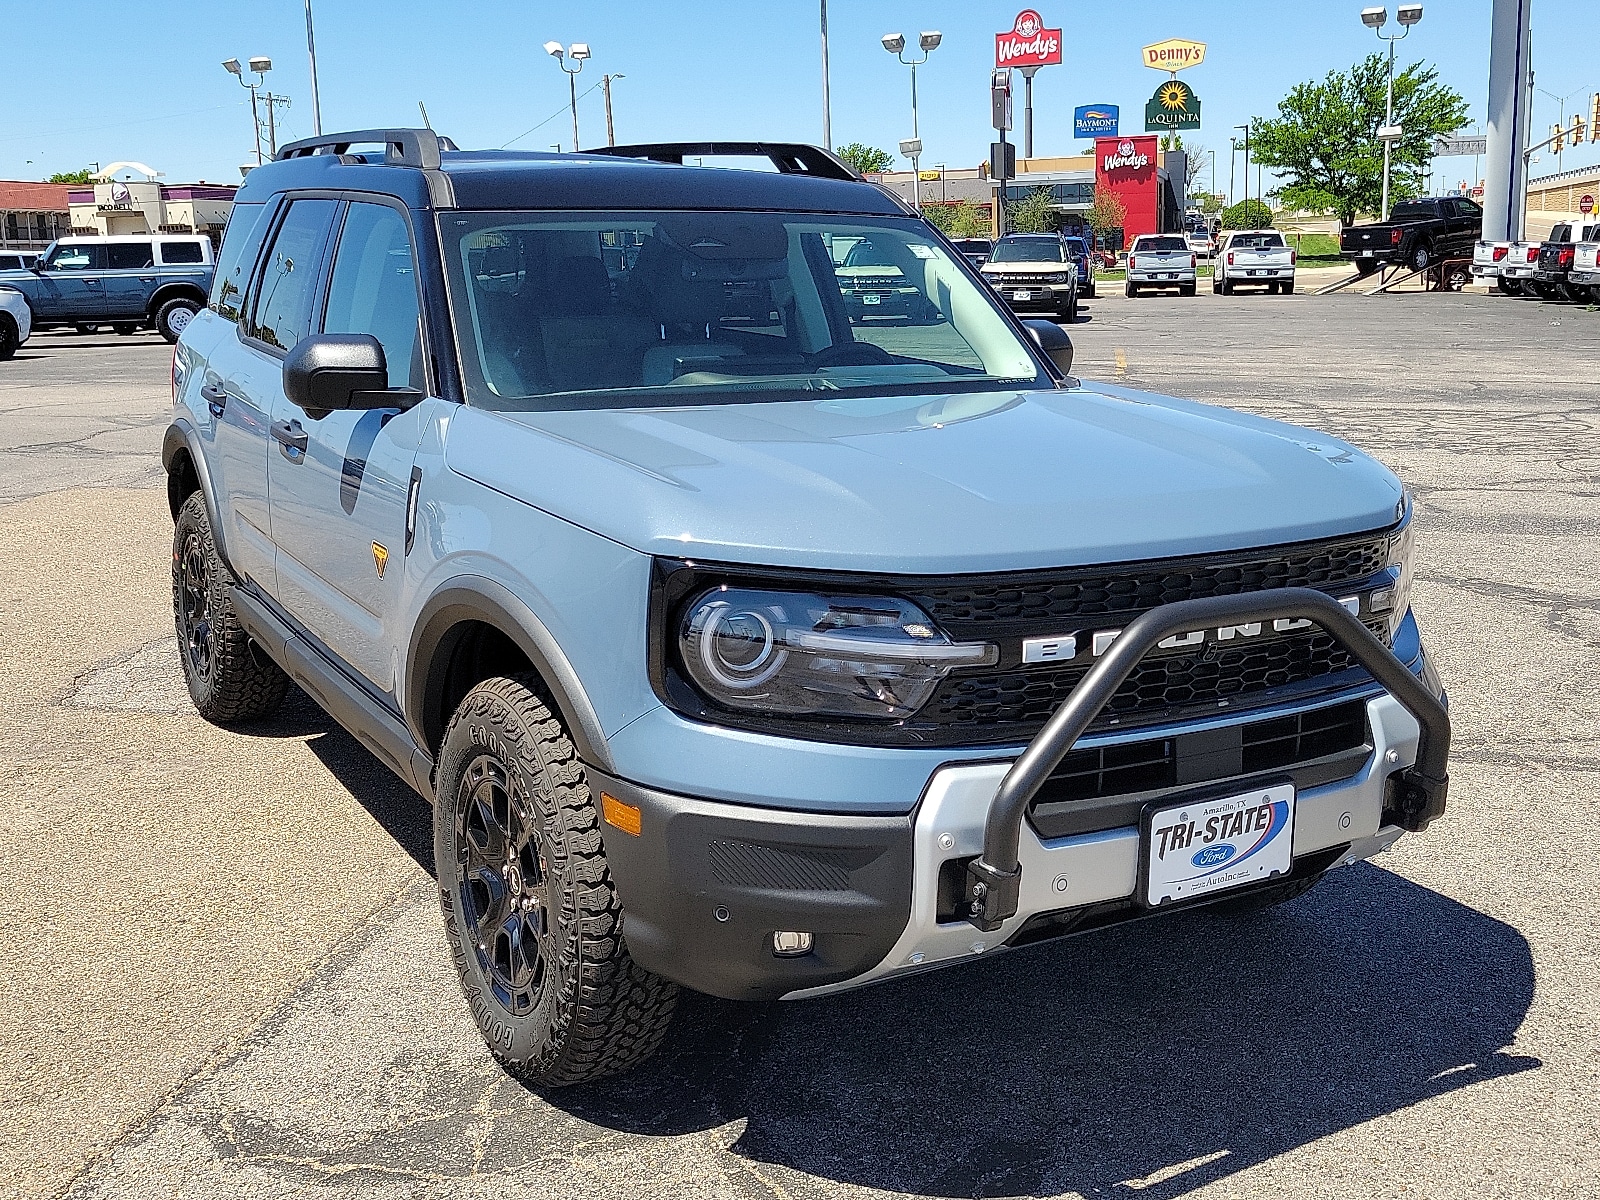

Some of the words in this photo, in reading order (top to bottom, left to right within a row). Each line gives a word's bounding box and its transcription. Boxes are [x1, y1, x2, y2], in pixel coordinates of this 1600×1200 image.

[998, 33, 1058, 63] Wendy's
[1148, 46, 1201, 63] Denny's
[1075, 119, 1118, 127] BAYMONT
[1104, 150, 1148, 171] Wendy's
[1021, 597, 1360, 663] BON
[1202, 803, 1236, 816] Amarillo,
[1236, 799, 1247, 809] TX
[1155, 804, 1271, 862] TRI-STATE
[1200, 847, 1228, 865] Ford
